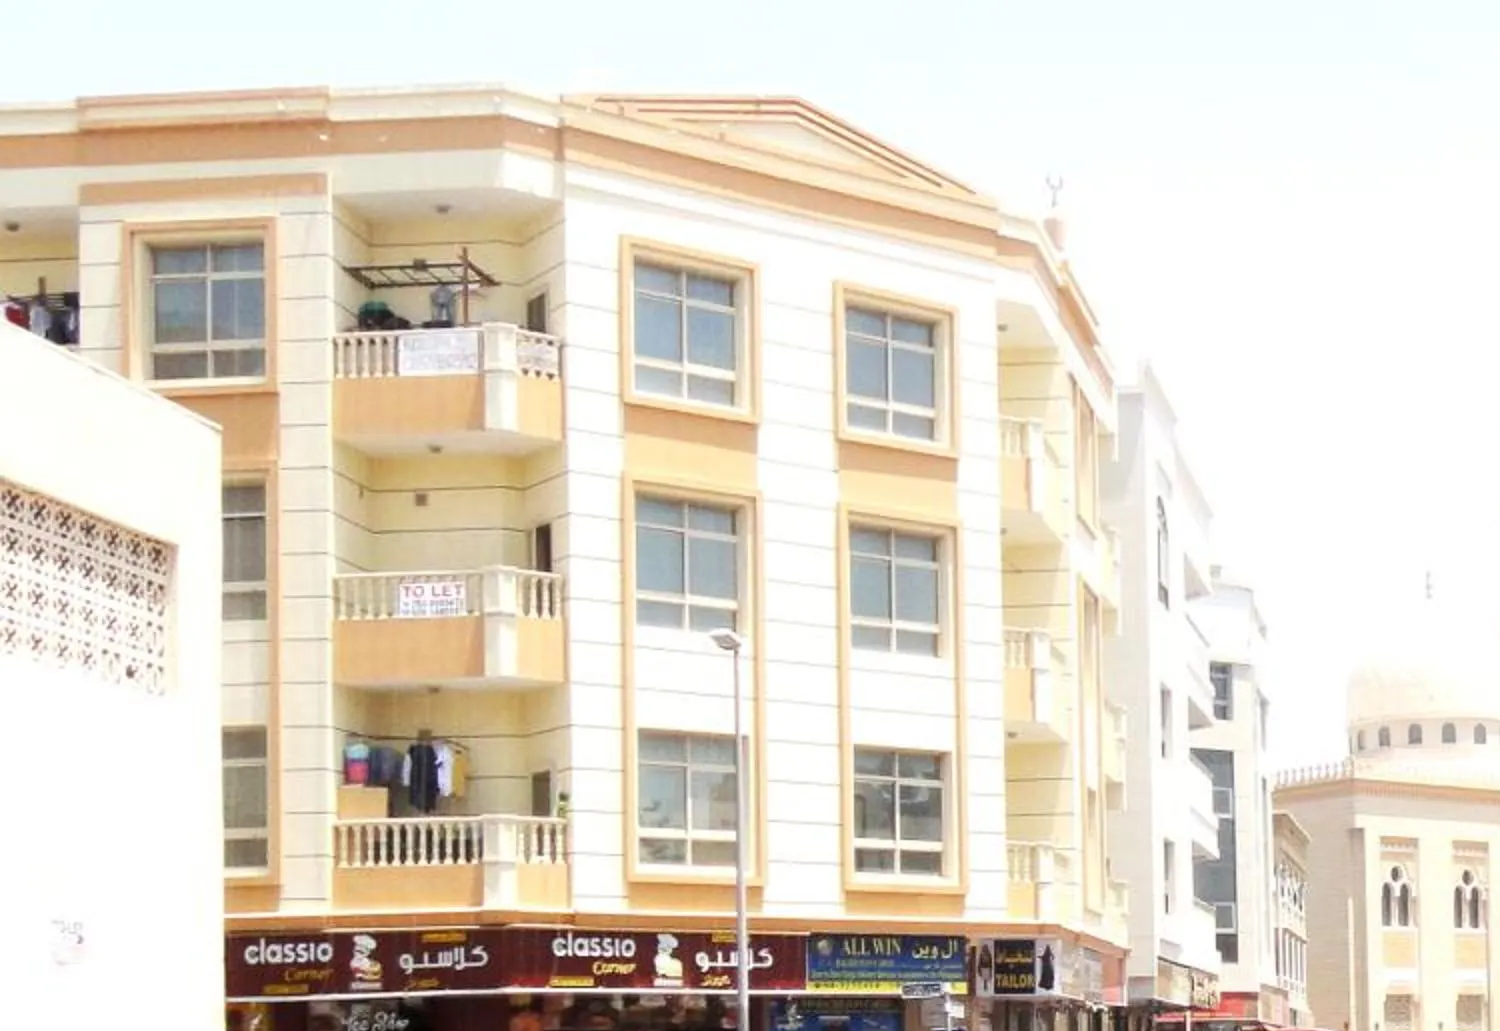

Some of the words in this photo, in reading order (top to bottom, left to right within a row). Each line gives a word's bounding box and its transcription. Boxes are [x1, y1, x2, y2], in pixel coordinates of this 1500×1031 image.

[403, 585, 425, 598] TO
[431, 583, 463, 597] LET
[873, 937, 901, 956] WIN
